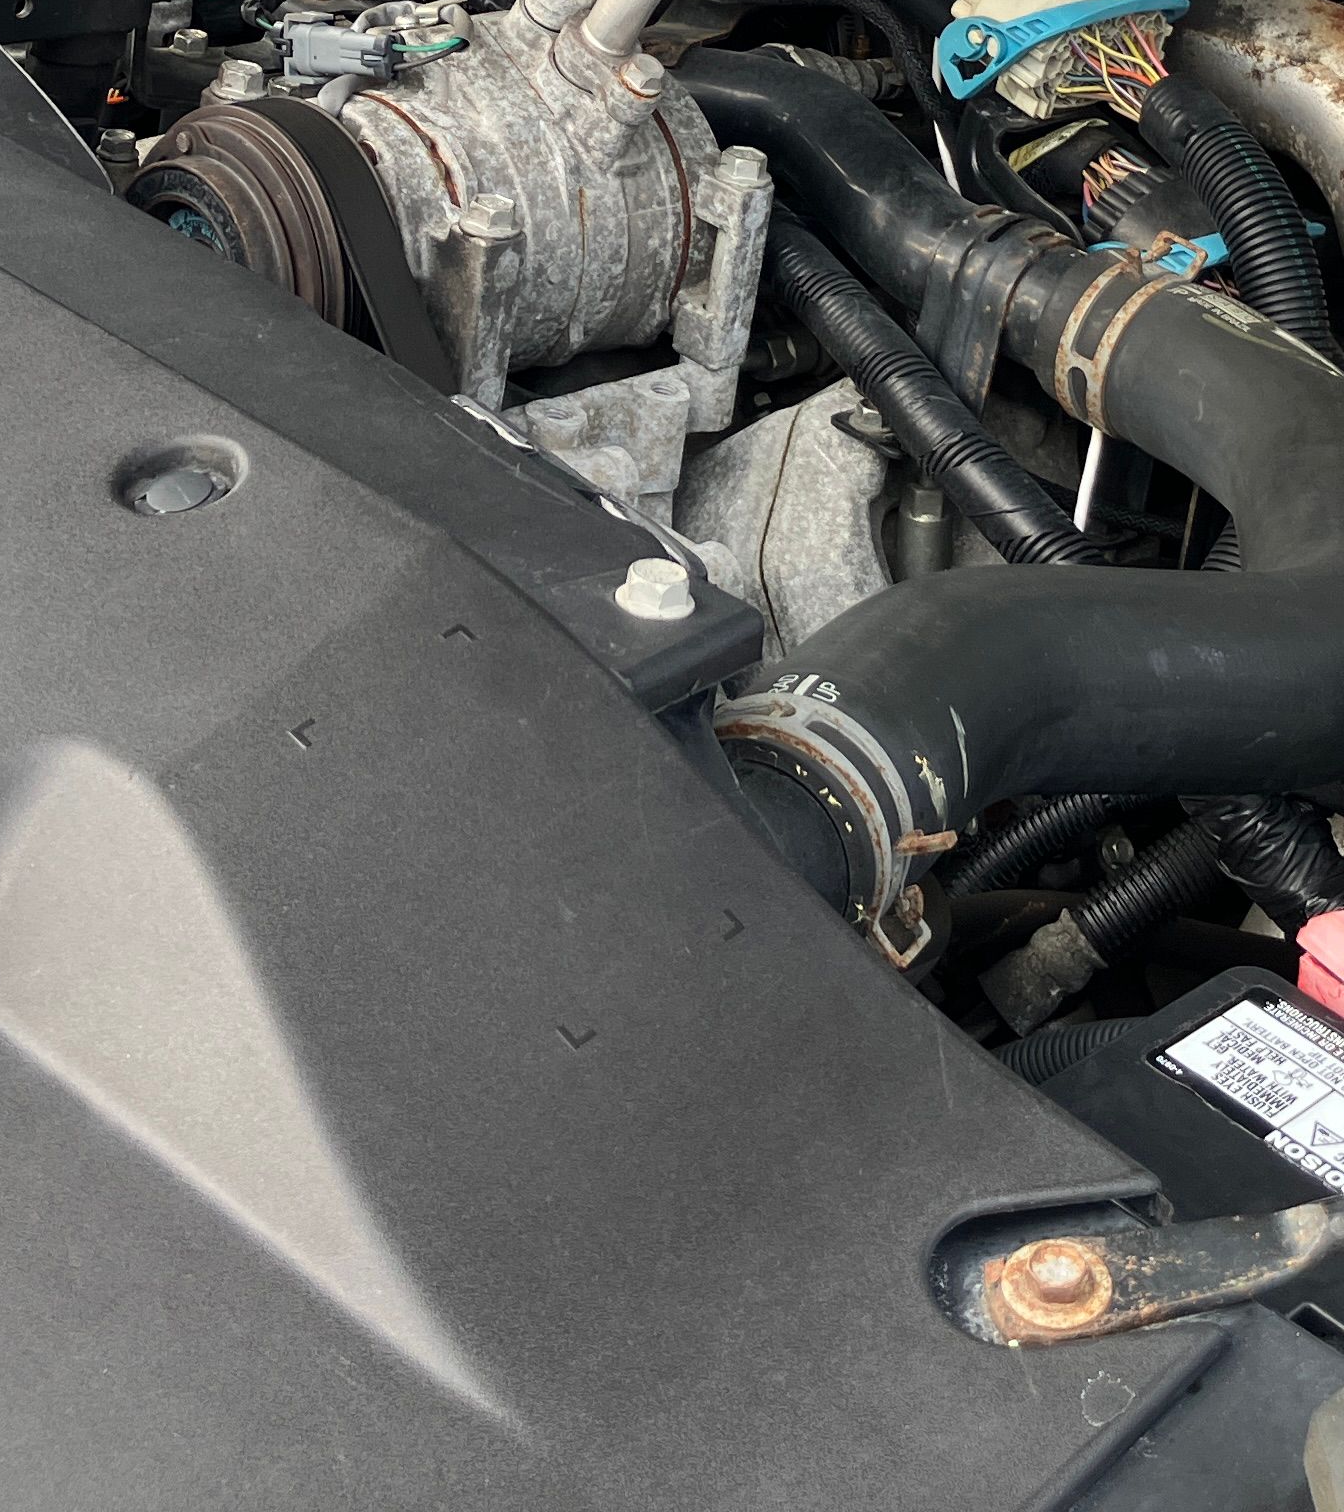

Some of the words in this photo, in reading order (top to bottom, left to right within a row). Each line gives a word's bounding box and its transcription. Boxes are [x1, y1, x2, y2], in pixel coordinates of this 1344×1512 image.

[811, 681, 841, 703] UP
[1201, 1036, 1229, 1053] GET
[1215, 1032, 1265, 1063] MEDICAL
[1318, 1037, 1336, 1048] OR
[1254, 1045, 1286, 1064] HELP
[1286, 1047, 1320, 1068] OPEN
[1209, 1072, 1243, 1093] EYES
[1209, 1060, 1289, 1109] IMMEDIATELY
[1316, 1068, 1342, 1084] NOT
[1264, 1081, 1298, 1102] WITH
[1239, 1092, 1278, 1116] FLUSH
